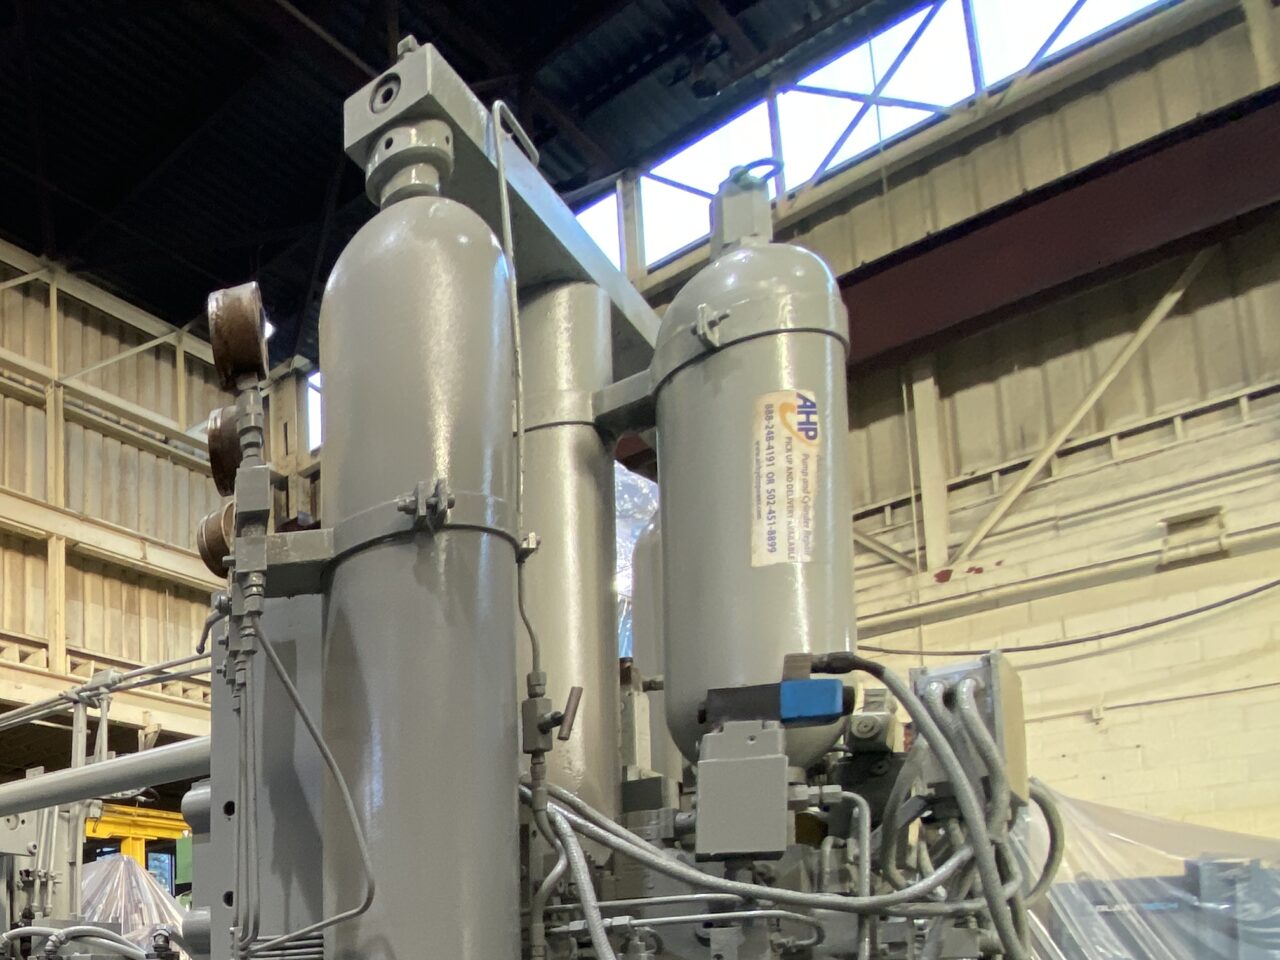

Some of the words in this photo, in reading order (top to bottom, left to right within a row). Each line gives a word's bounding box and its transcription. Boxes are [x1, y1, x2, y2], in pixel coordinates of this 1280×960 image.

[796, 392, 818, 441] AHP
[764, 404, 775, 467] 888-248-4191
[785, 454, 793, 465] UP
[800, 453, 810, 477] Pump
[766, 472, 775, 485] OR
[786, 467, 794, 483] AND
[802, 478, 810, 494] and
[786, 484, 794, 518] DELIVERY
[801, 495, 811, 529] Cylinder
[766, 488, 777, 553] 502-451-8899
